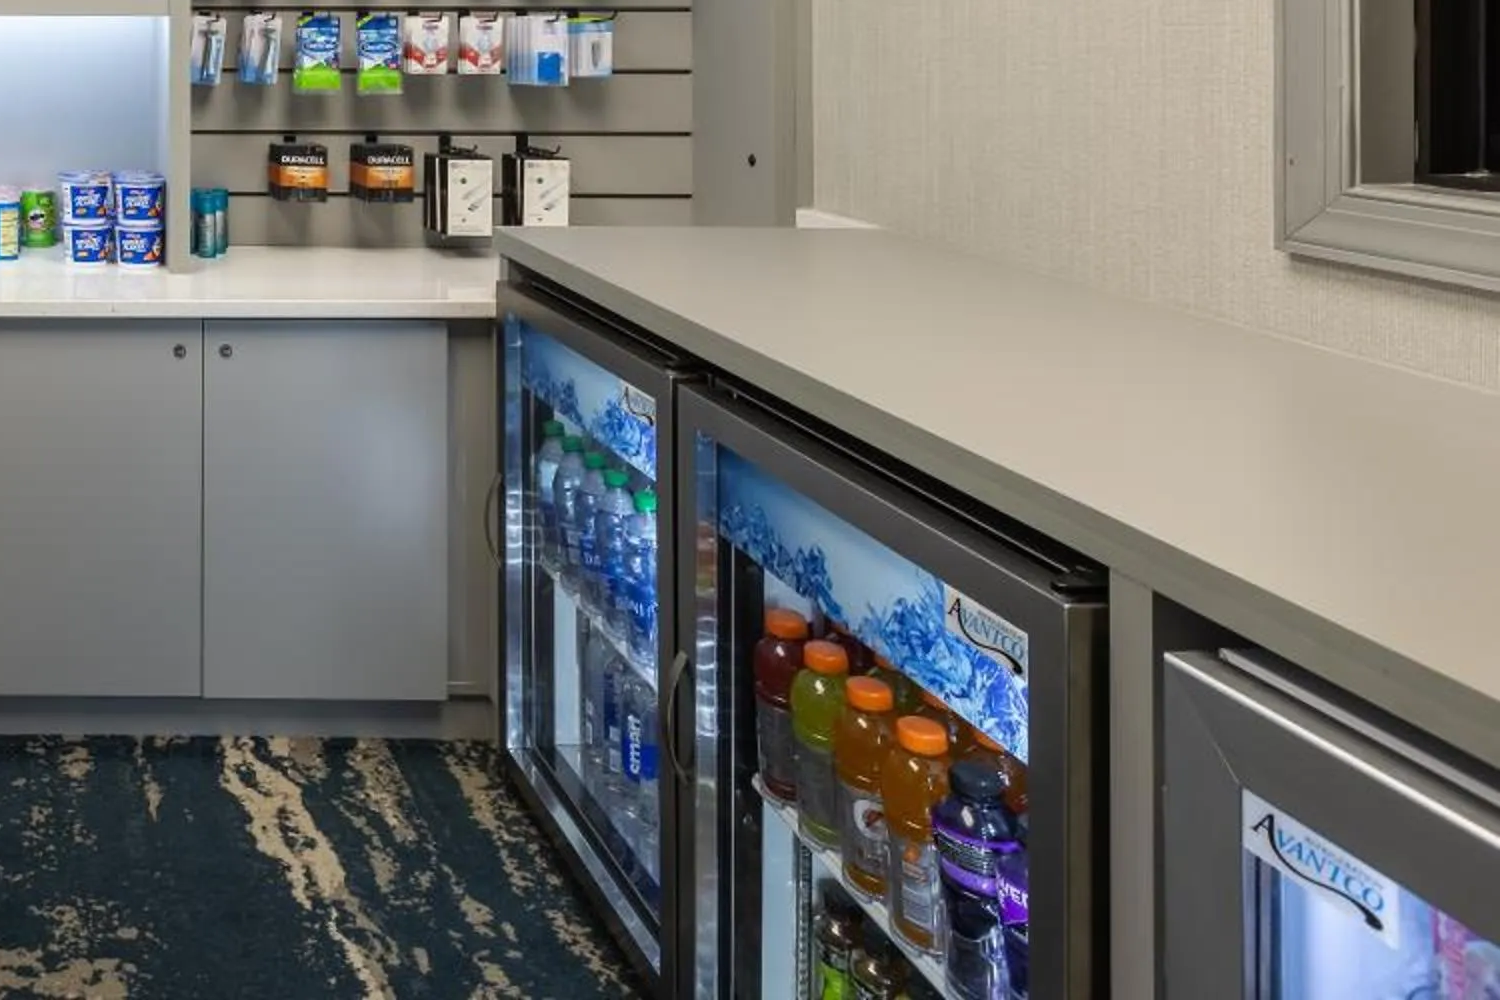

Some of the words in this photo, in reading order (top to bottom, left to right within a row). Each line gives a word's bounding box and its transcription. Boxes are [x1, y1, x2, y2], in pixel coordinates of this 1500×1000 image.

[281, 155, 324, 165] DURACELL
[368, 155, 411, 165] DURACELL
[948, 598, 1024, 664] AVANTCO
[628, 715, 641, 775] smart
[1252, 813, 1384, 916] AVANTCO
